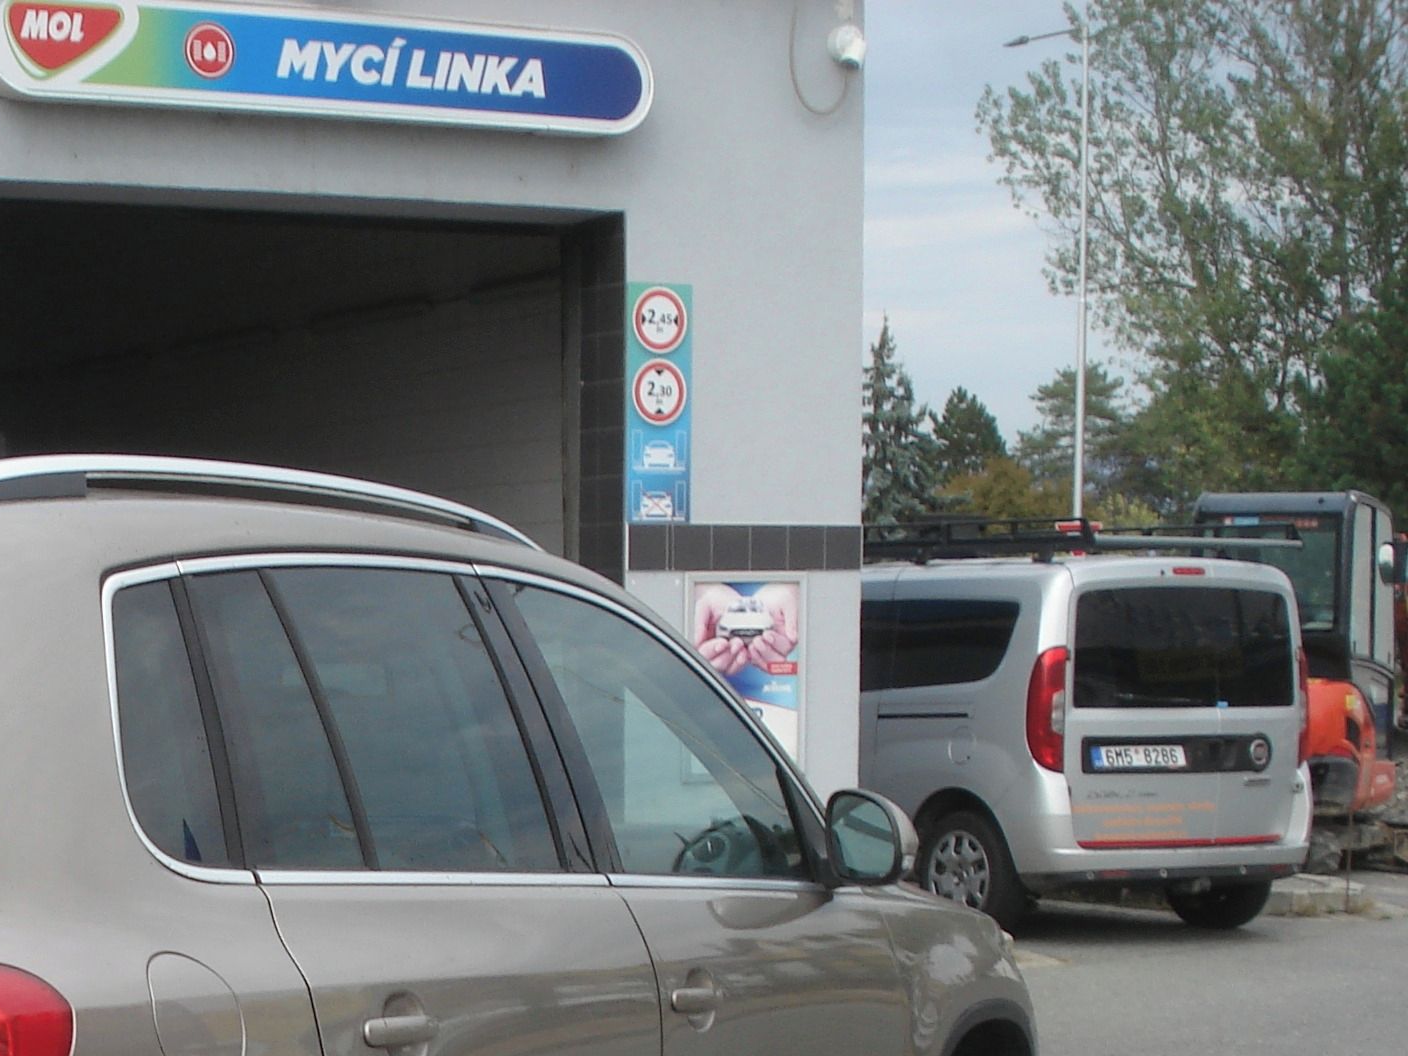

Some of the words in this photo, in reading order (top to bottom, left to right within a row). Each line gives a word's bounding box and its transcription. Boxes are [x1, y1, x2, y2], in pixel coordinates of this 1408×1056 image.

[20, 8, 84, 42] MOL
[276, 37, 406, 87] MYCÍ
[406, 49, 546, 99] LINKA
[1144, 746, 1179, 765] 8286
